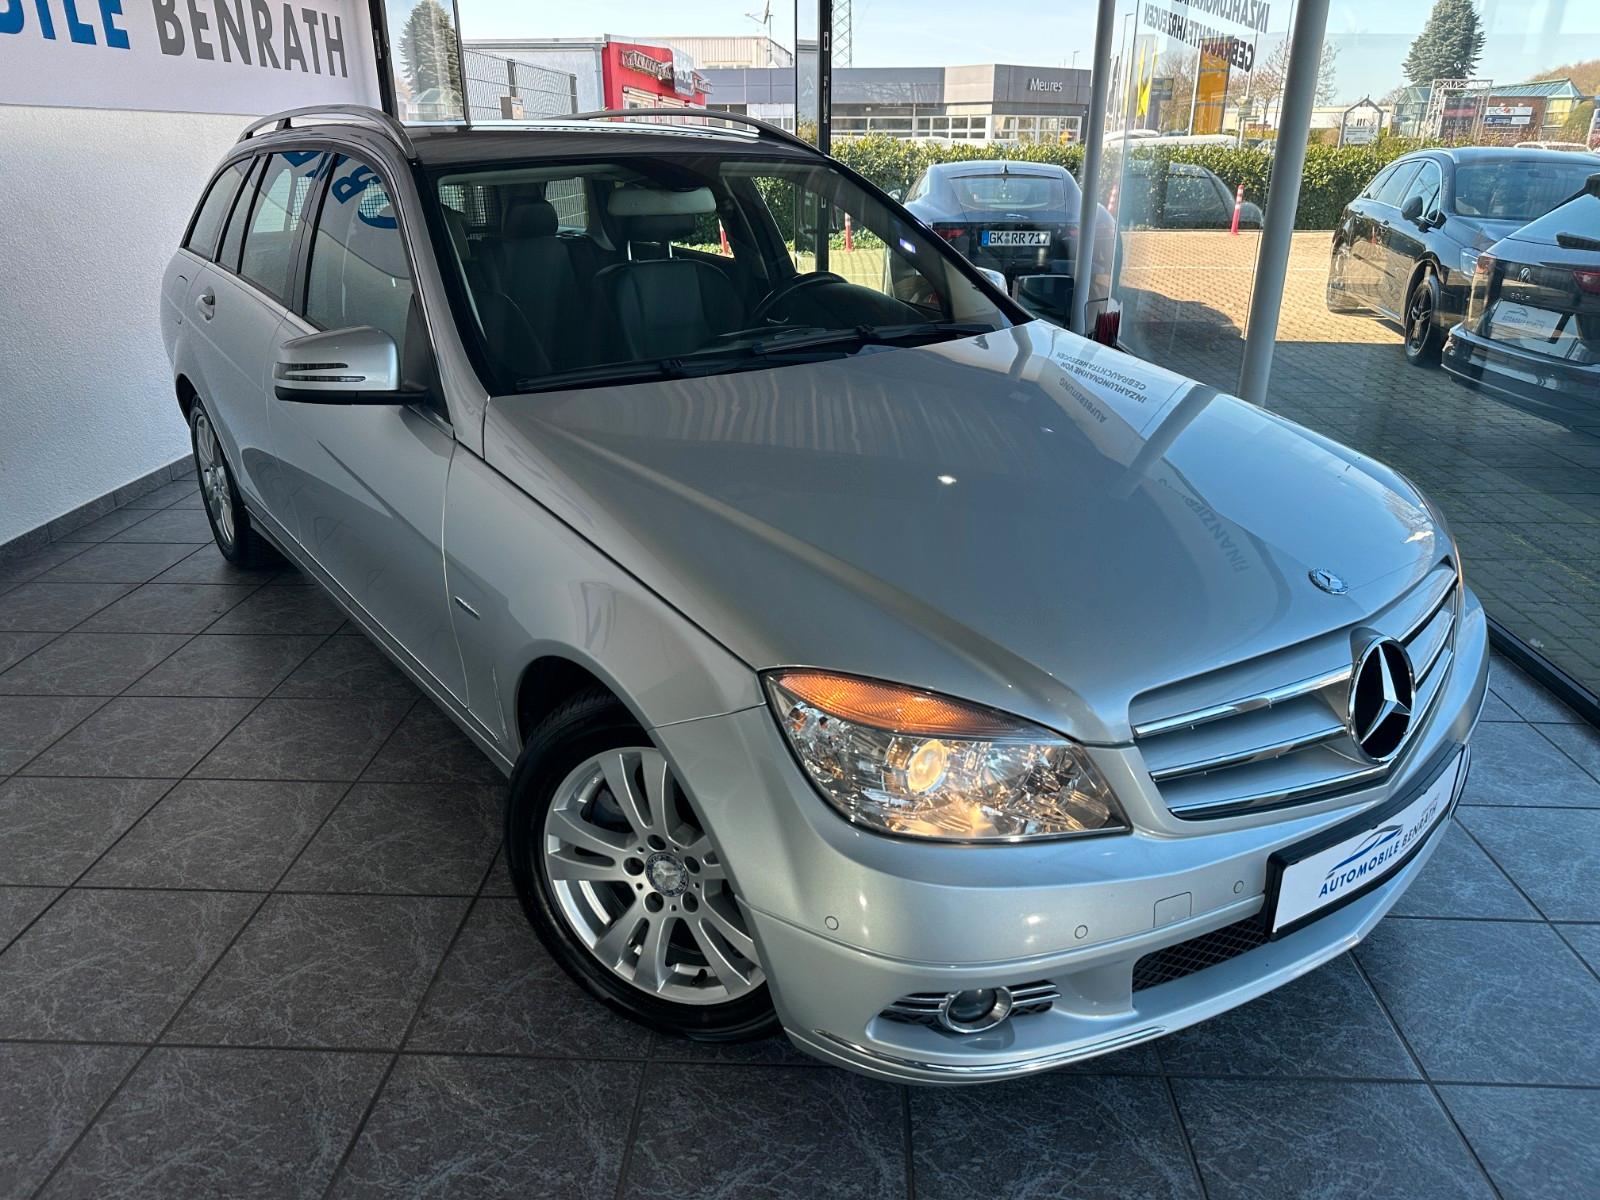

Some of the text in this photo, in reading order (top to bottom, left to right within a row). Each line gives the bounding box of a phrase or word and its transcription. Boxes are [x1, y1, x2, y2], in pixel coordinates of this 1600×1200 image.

[152, 0, 348, 78] BENRATH
[1030, 77, 1063, 92] Meures
[990, 232, 1004, 244] GK
[1011, 232, 1026, 244] RR
[1318, 804, 1438, 898] AUTOMOBILE BENRATH
